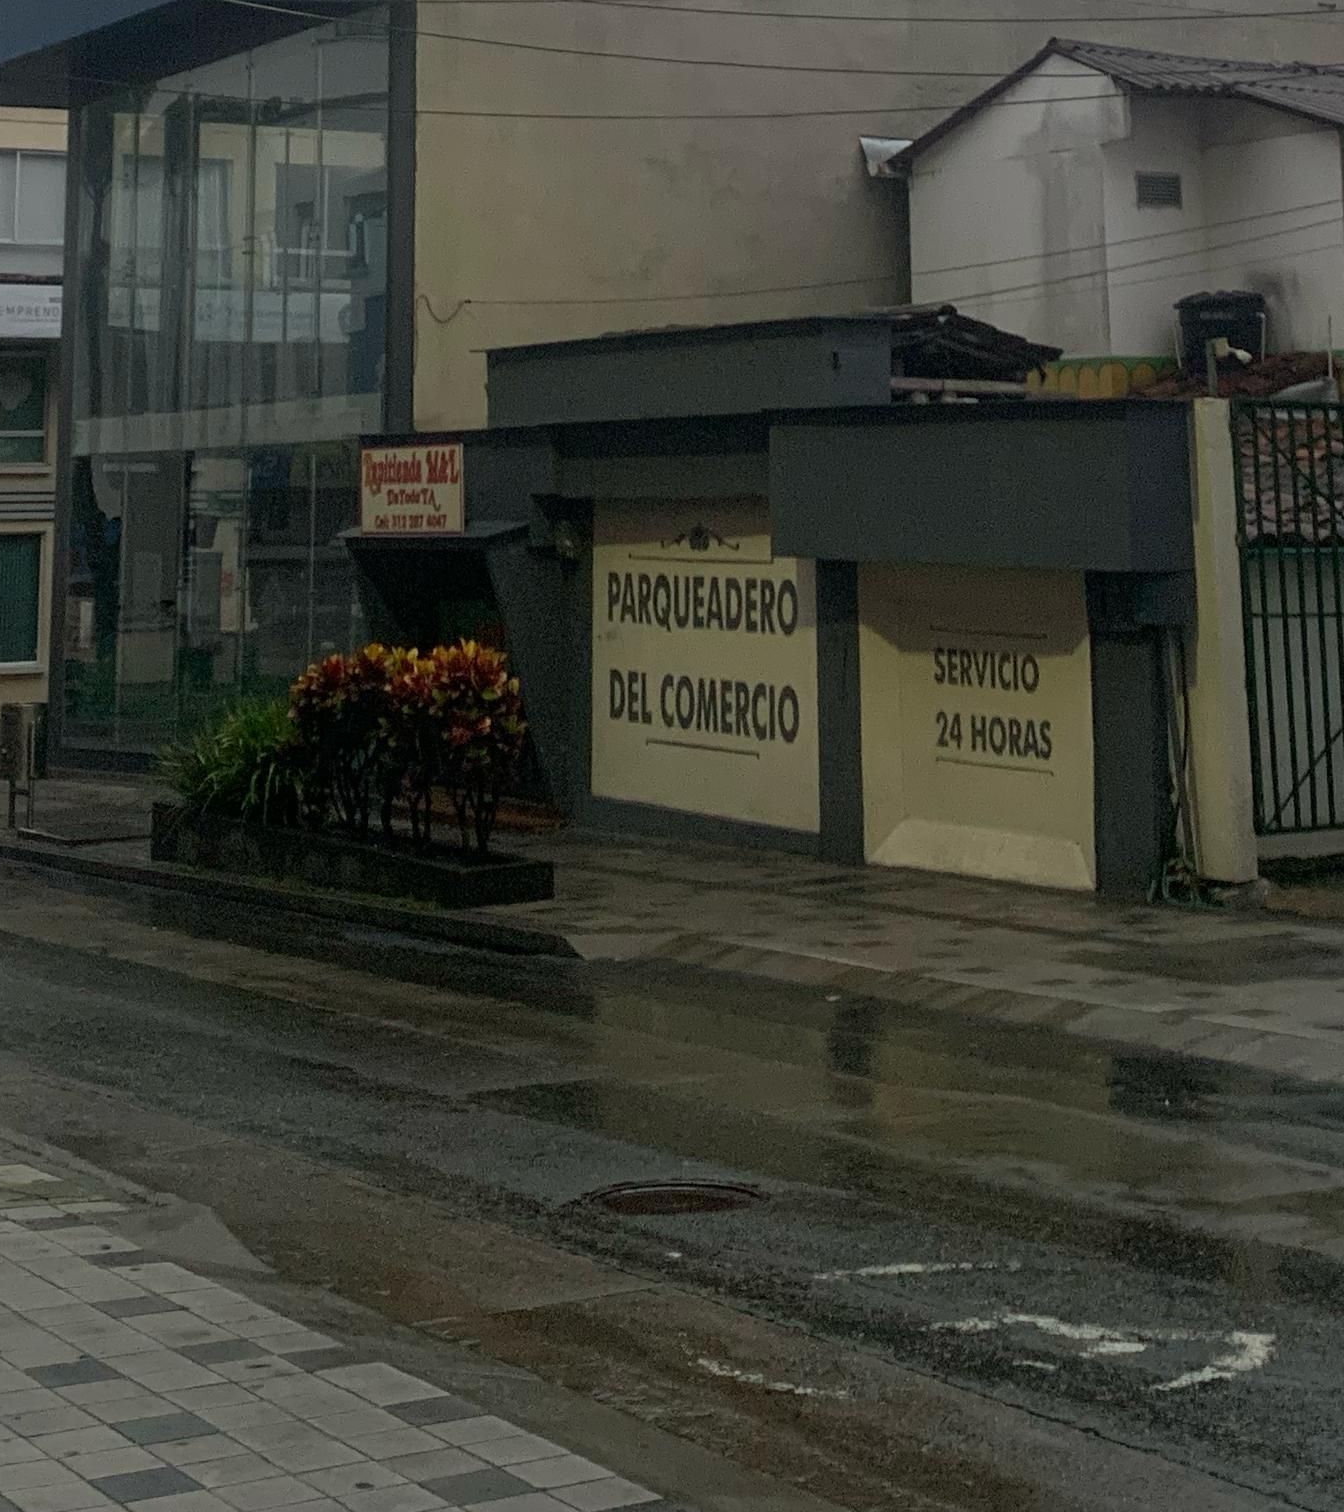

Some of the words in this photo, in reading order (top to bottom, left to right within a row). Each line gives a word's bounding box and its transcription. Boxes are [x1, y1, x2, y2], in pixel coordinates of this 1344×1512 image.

[607, 571, 799, 636] PARQUEADERO
[934, 646, 1040, 693] SERVICIO
[609, 669, 652, 724] DEL
[660, 674, 800, 744] COMERCIO
[936, 711, 962, 750] 24
[970, 715, 1052, 761] HORAS
